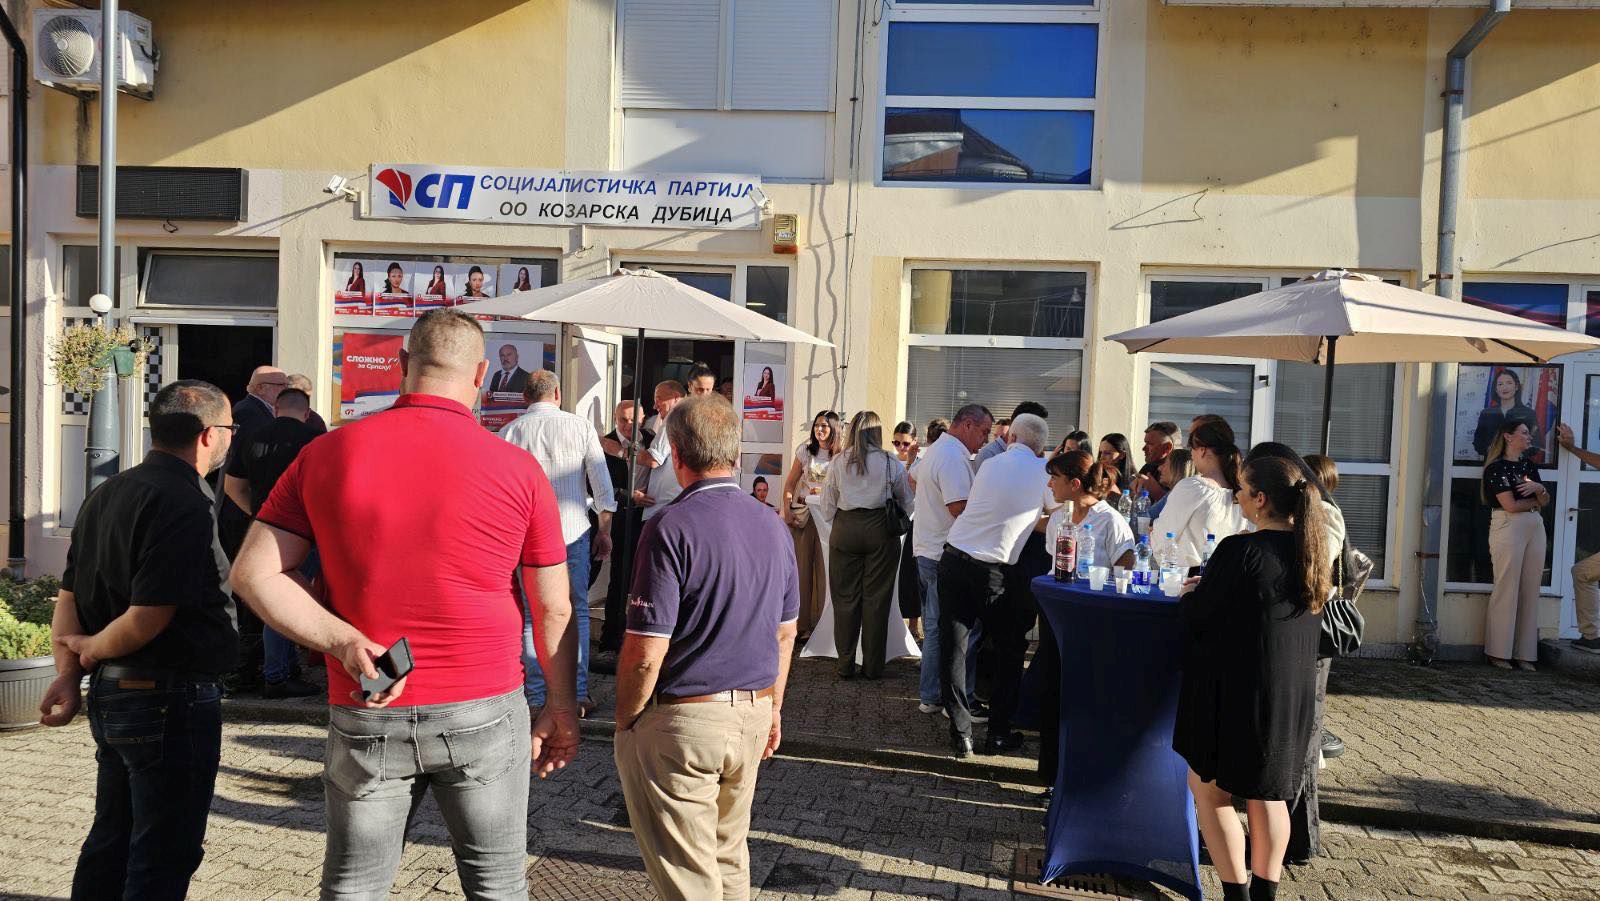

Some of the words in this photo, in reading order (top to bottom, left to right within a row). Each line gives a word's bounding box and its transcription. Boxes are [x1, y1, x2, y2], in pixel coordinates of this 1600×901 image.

[414, 173, 476, 210] СП
[480, 175, 657, 196] СОЦИЈАЛИСТИЧКА
[667, 180, 753, 199] ПАРТИЈА
[499, 201, 528, 217] ОО
[538, 202, 640, 220] КОЗАРСКА
[651, 206, 733, 226] ДУБИЦА
[346, 355, 385, 364] СЛОЖНО
